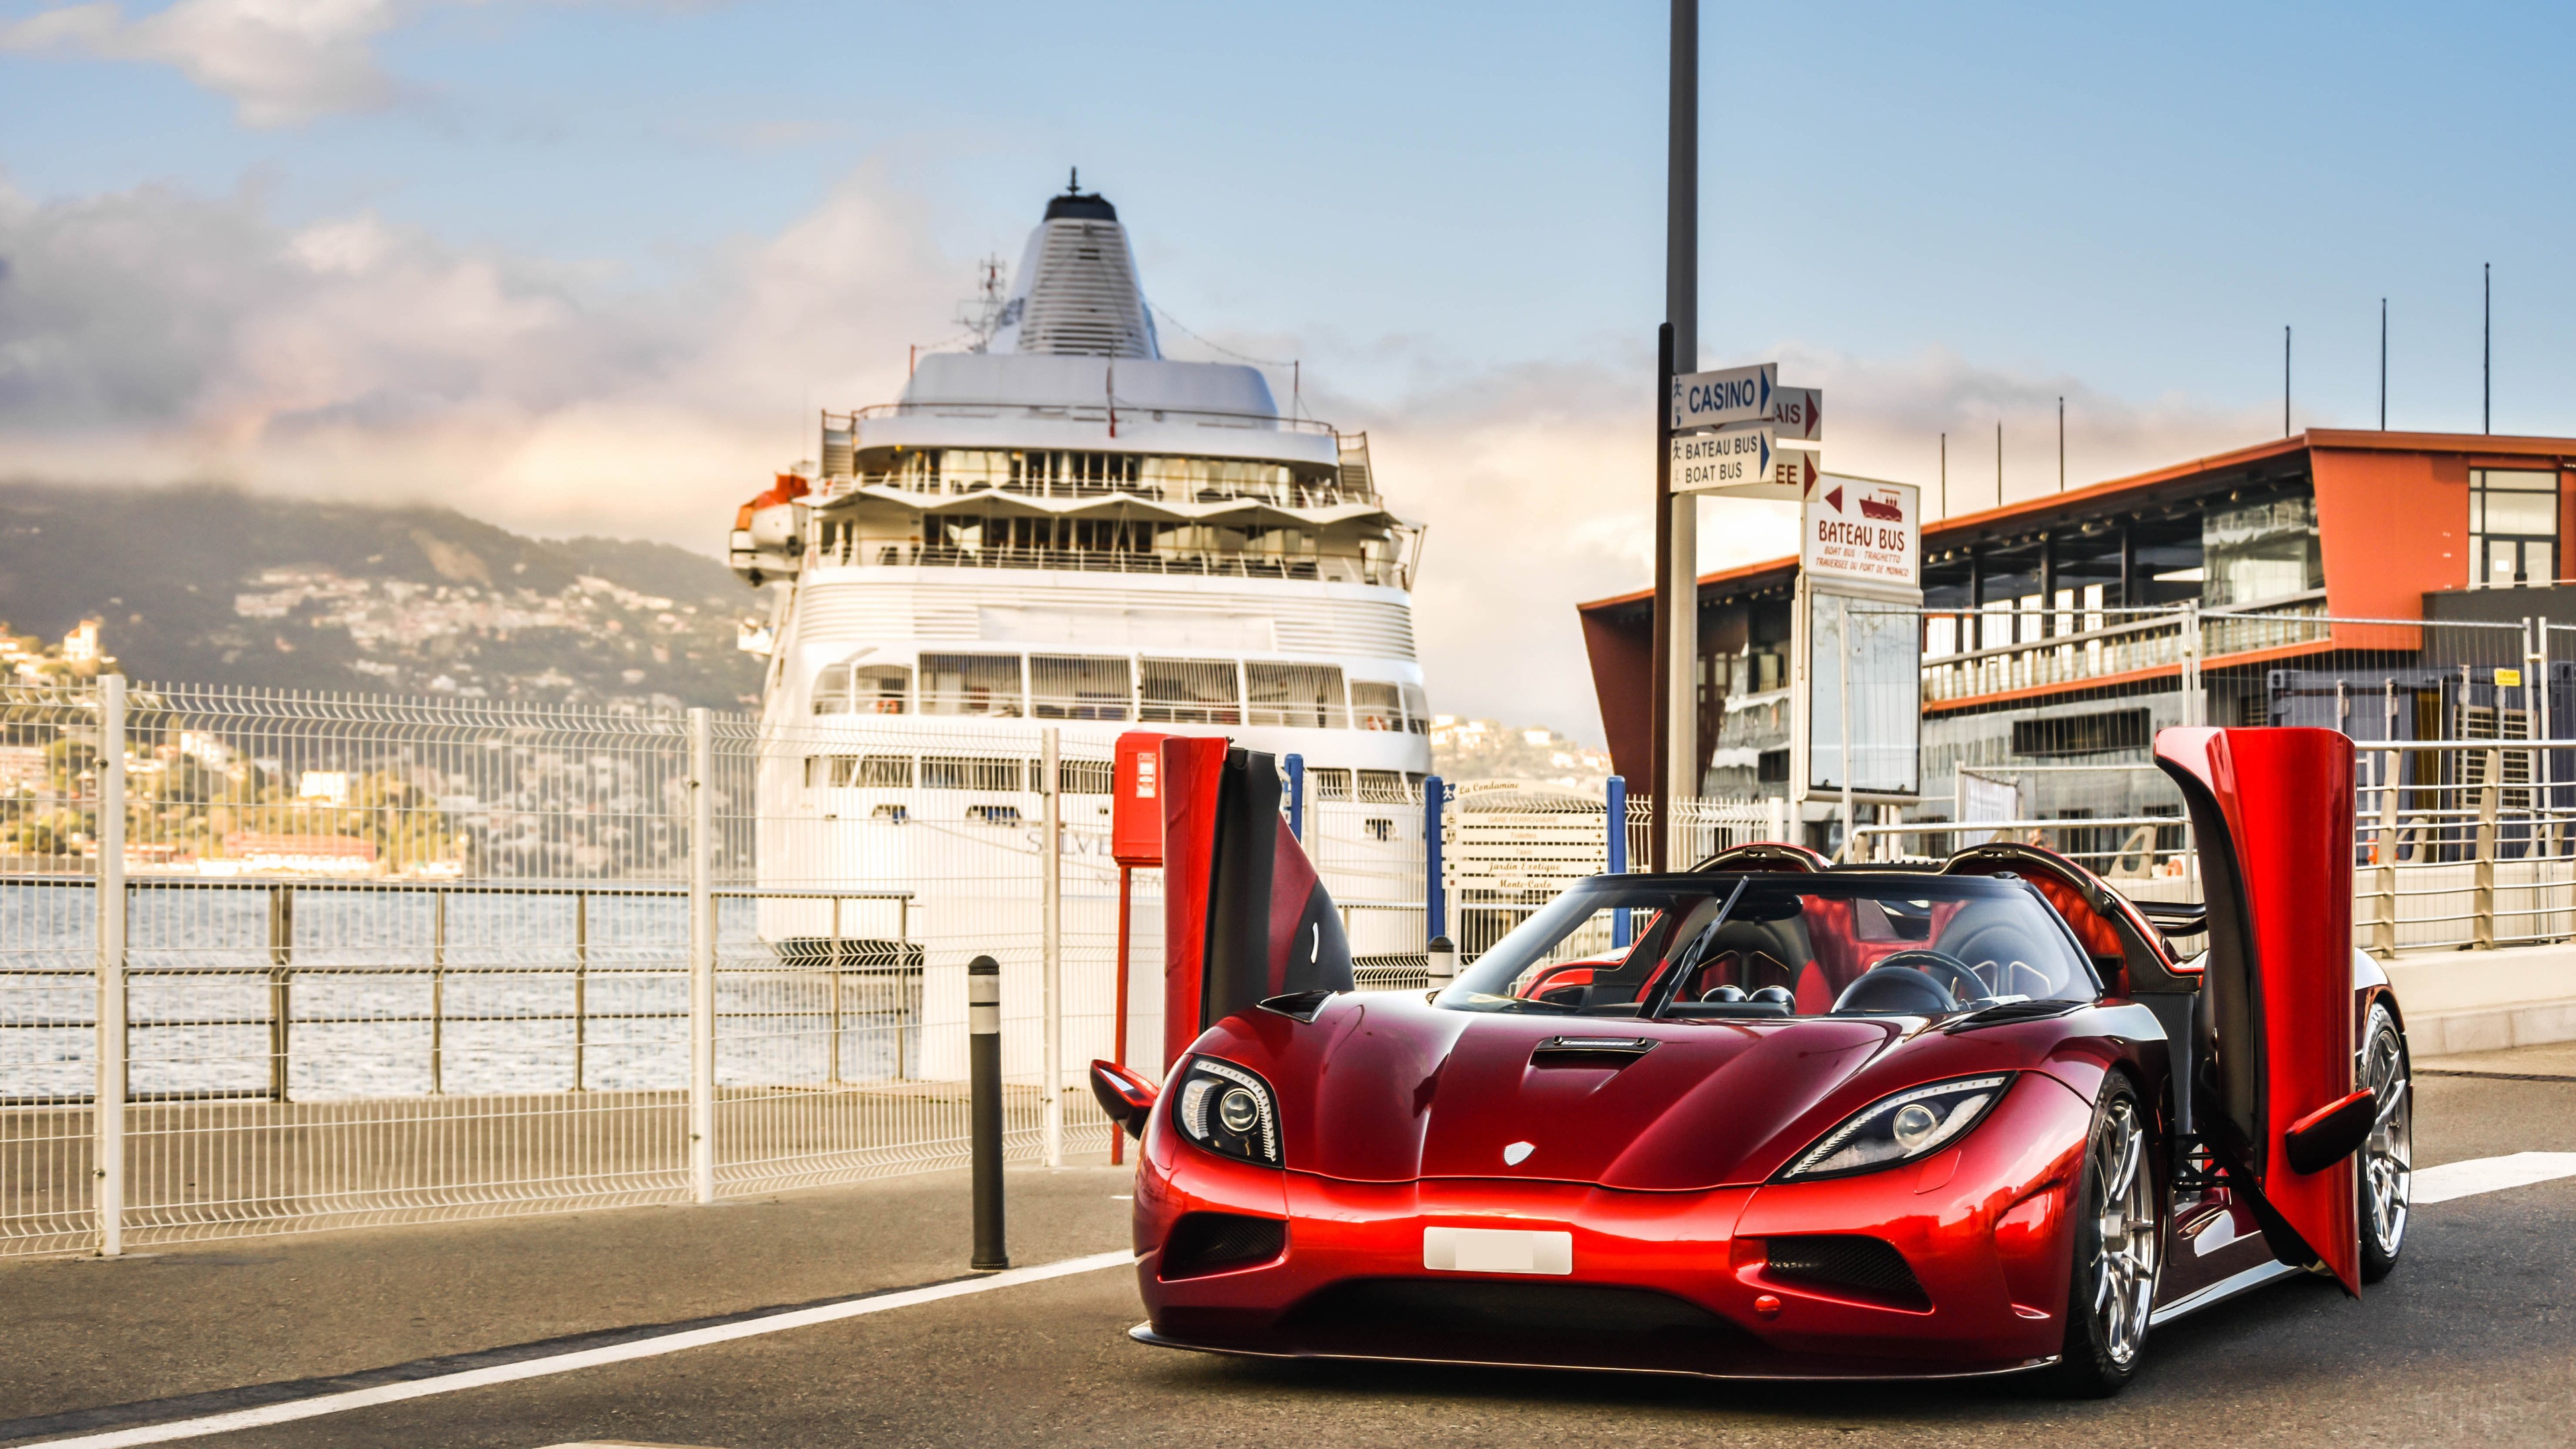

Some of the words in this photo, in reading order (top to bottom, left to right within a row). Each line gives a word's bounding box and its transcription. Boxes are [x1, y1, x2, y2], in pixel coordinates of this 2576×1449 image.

[1689, 378, 1755, 413] CASINO
[1686, 439, 1731, 460] BATEAU
[1735, 436, 1758, 454] BUS
[1685, 465, 1716, 483] BOAT
[1720, 462, 1743, 480] BUS
[1819, 520, 1872, 547] BATEAU
[1879, 528, 1904, 551] BUS
[1824, 545, 1842, 555] BOAT
[1843, 548, 1856, 557] BUS
[1864, 551, 1901, 564] TRAGHETTO
[1850, 561, 1858, 570] DU
[1859, 562, 1875, 573] PORT
[1876, 565, 1884, 574] DE
[1886, 566, 1909, 578] MONACO
[1459, 785, 1470, 795] La
[1472, 780, 1519, 792] Condamine
[1509, 816, 1559, 824] FERROVIAIRE
[1489, 862, 1517, 872] Jardin
[1521, 863, 1560, 873] Exotique
[1498, 879, 1552, 888] Monte-Carlo
